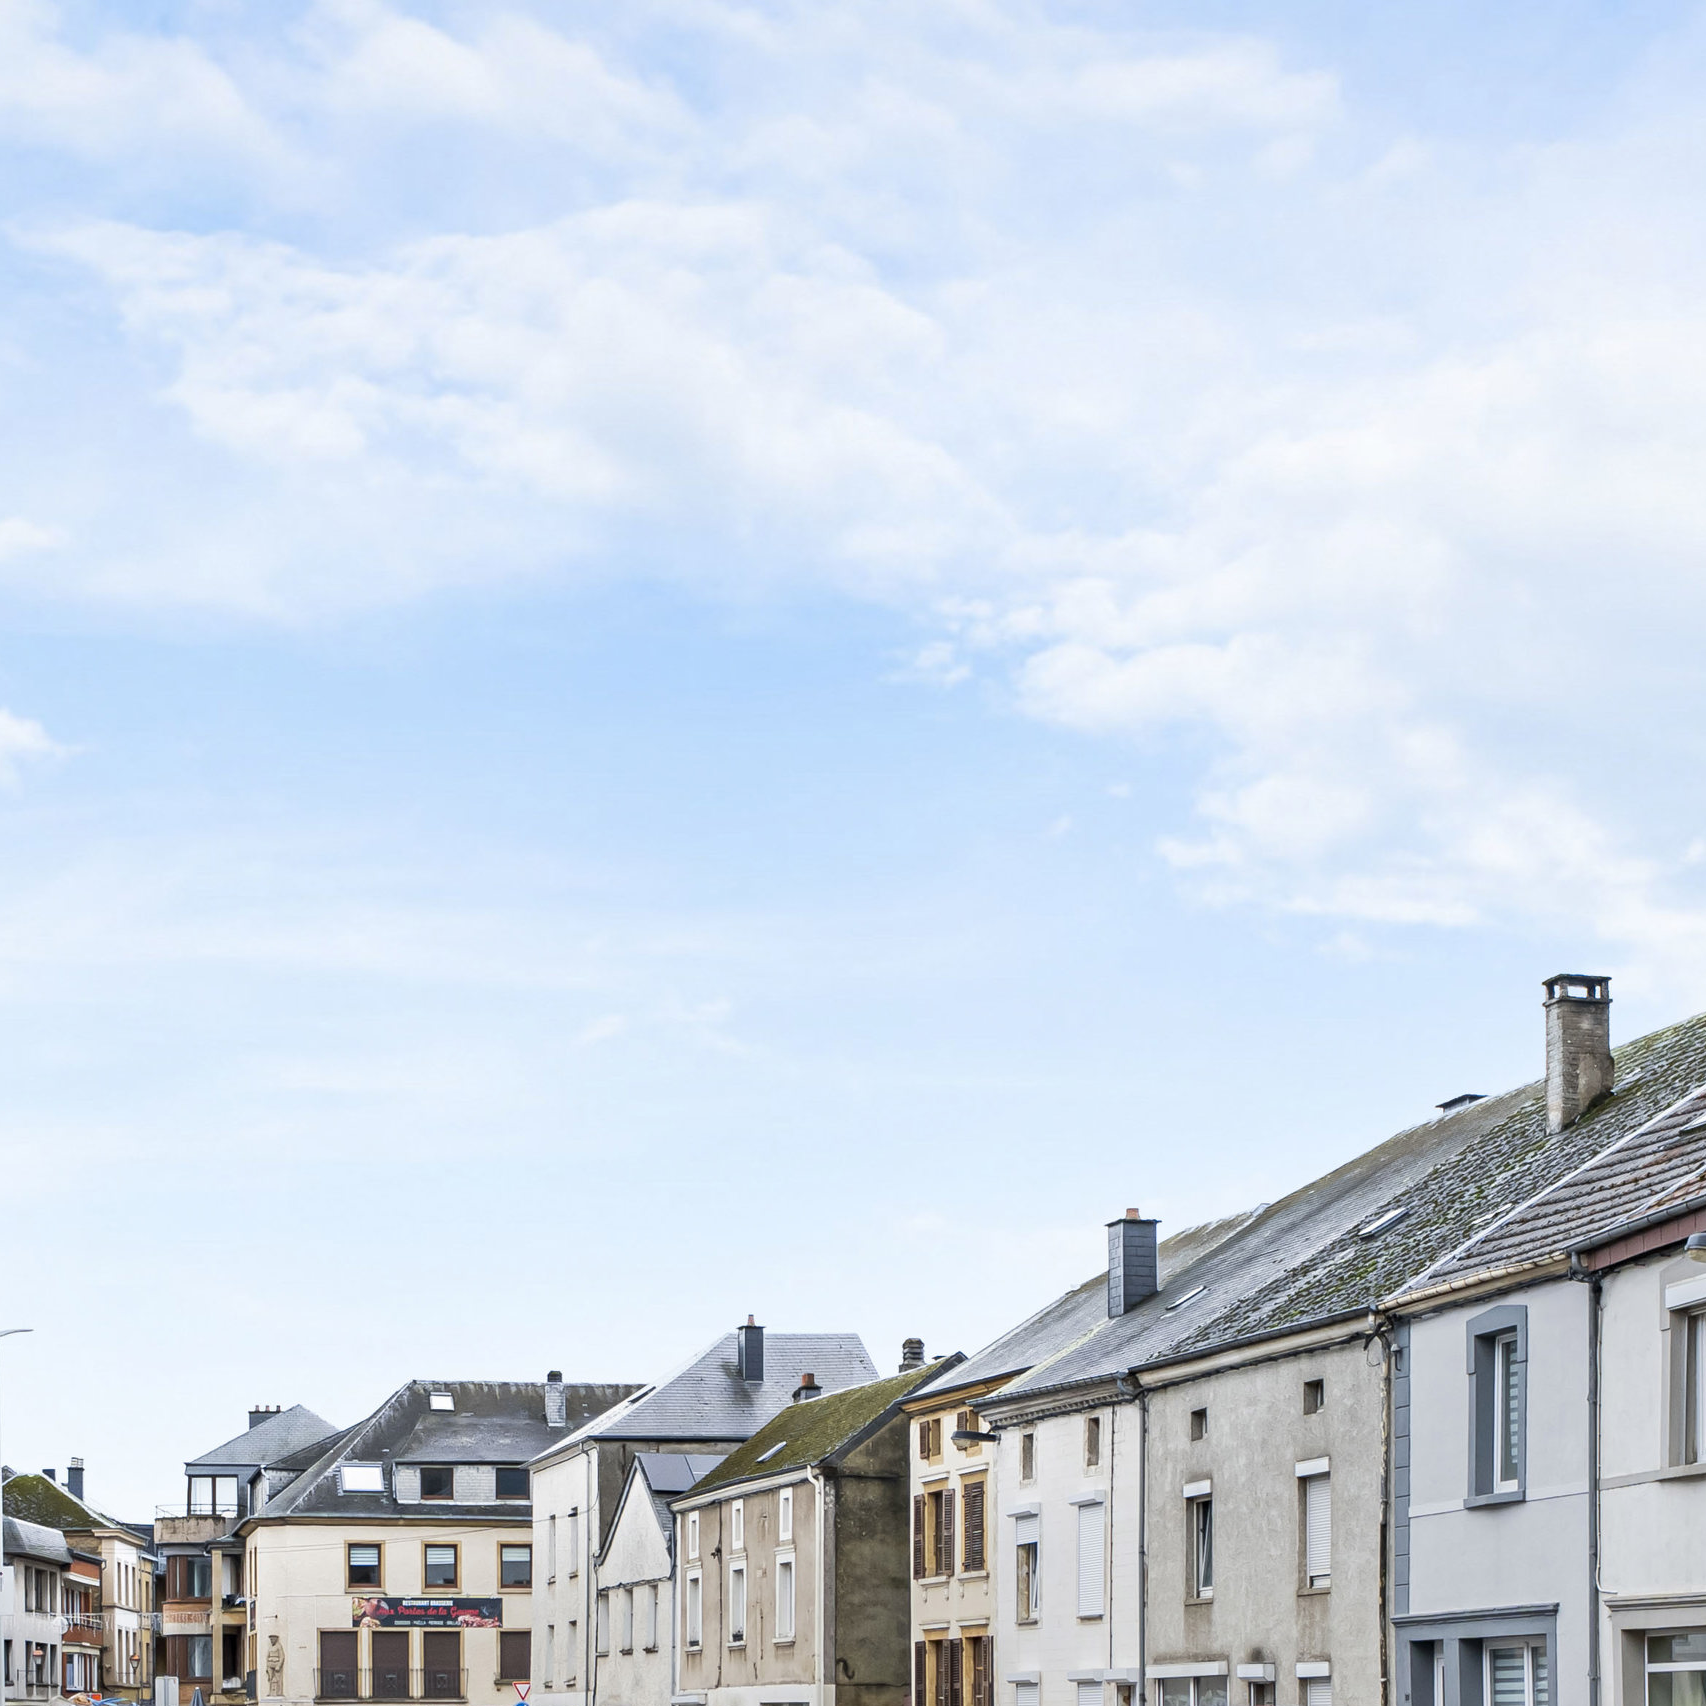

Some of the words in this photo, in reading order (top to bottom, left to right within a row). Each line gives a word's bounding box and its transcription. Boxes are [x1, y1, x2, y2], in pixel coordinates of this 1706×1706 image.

[427, 1606, 437, 1615] de
[438, 1606, 448, 1615] la
[450, 1606, 480, 1618] Gaume
